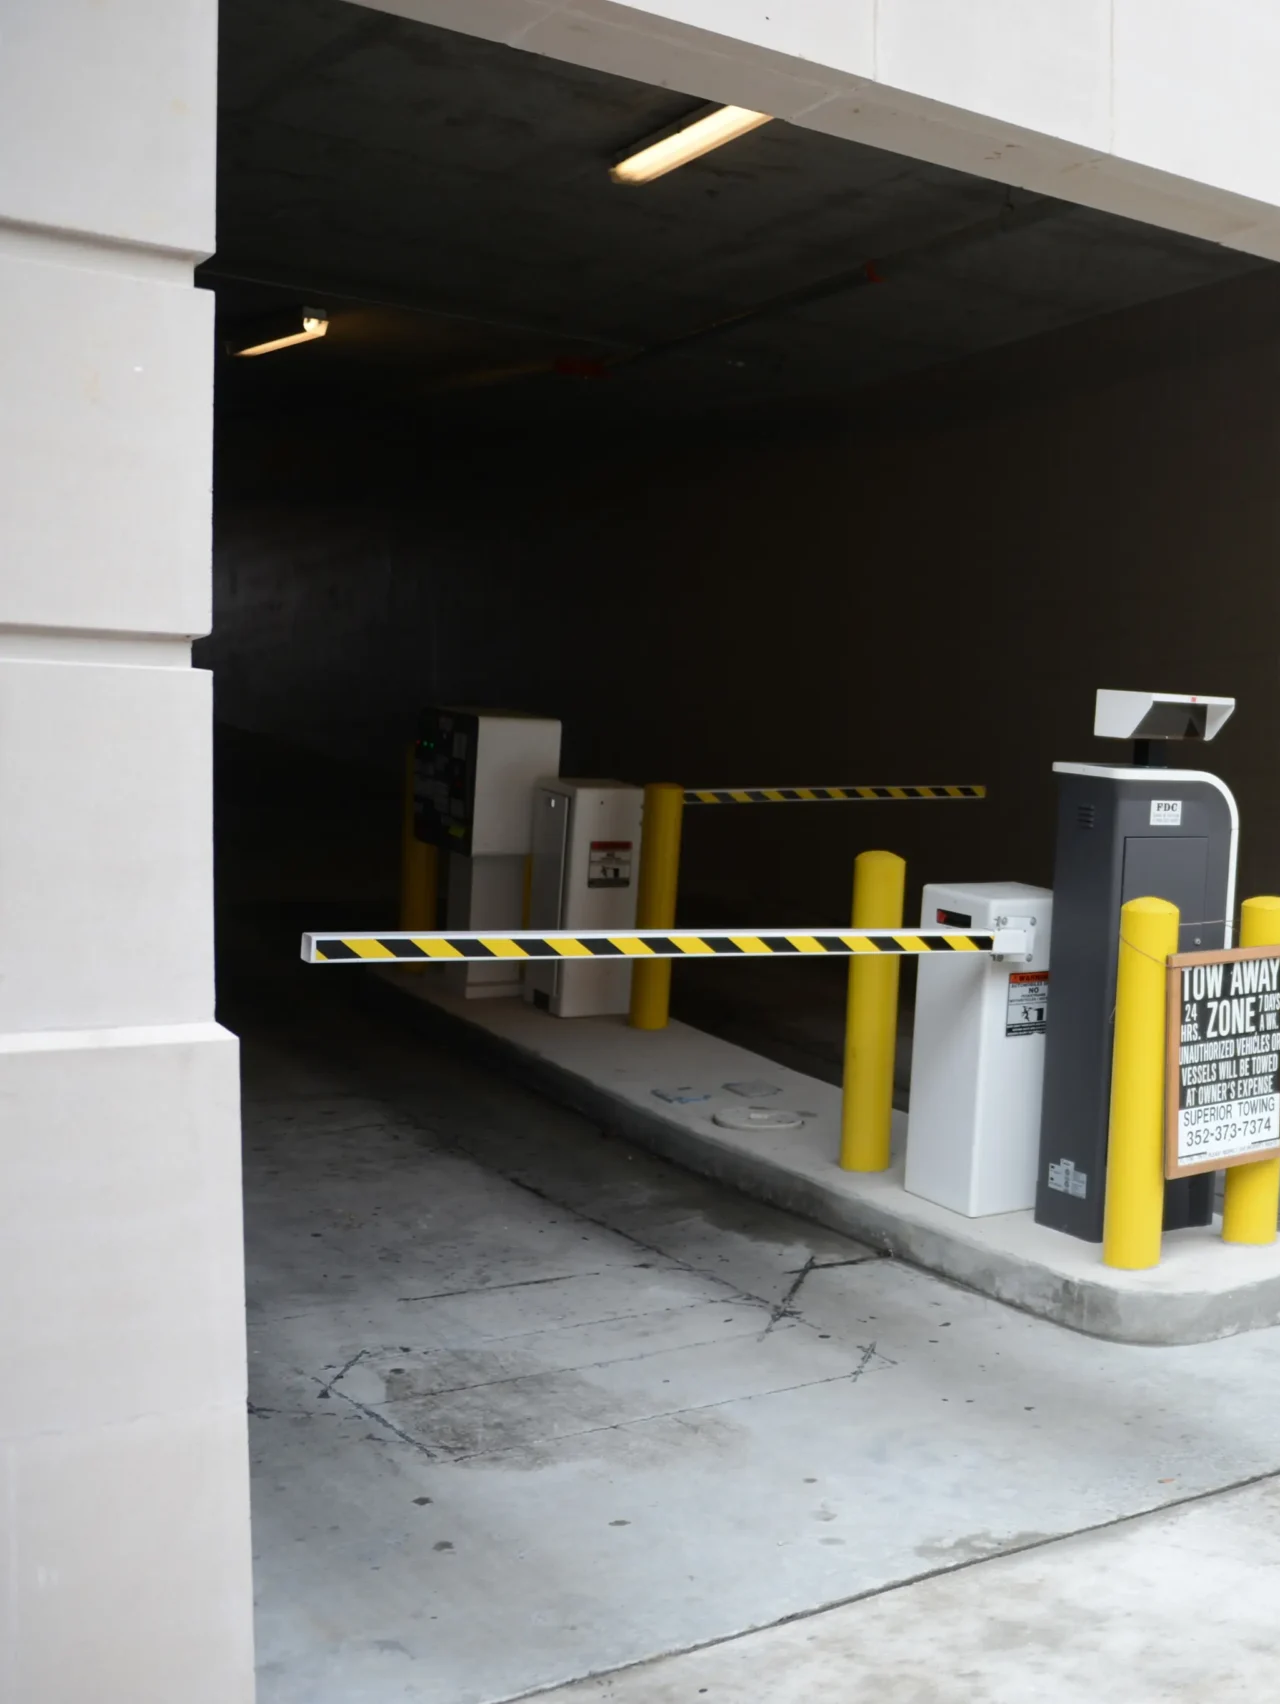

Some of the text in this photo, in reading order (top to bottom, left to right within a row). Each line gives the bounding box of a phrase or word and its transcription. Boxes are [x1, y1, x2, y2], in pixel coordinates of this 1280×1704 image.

[1156, 802, 1178, 812] FDC
[1182, 957, 1280, 1002] TOW AWAY
[1185, 1003, 1198, 1022] 24
[1206, 996, 1257, 1039] ZONE
[1259, 995, 1264, 1012] 7
[1181, 1022, 1202, 1043] HRS.
[1259, 1014, 1265, 1032] A
[1179, 1039, 1236, 1066] UNAUTHORIZED
[1236, 1034, 1271, 1057] VEHICLES
[1182, 1053, 1279, 1087] VESSELS WILL BE TOWED
[1186, 1074, 1274, 1108] AT OWNER'S EXPENSE
[1183, 1096, 1275, 1127] SUPERIOR TOWING
[1186, 1116, 1272, 1147] 352-373-7374
